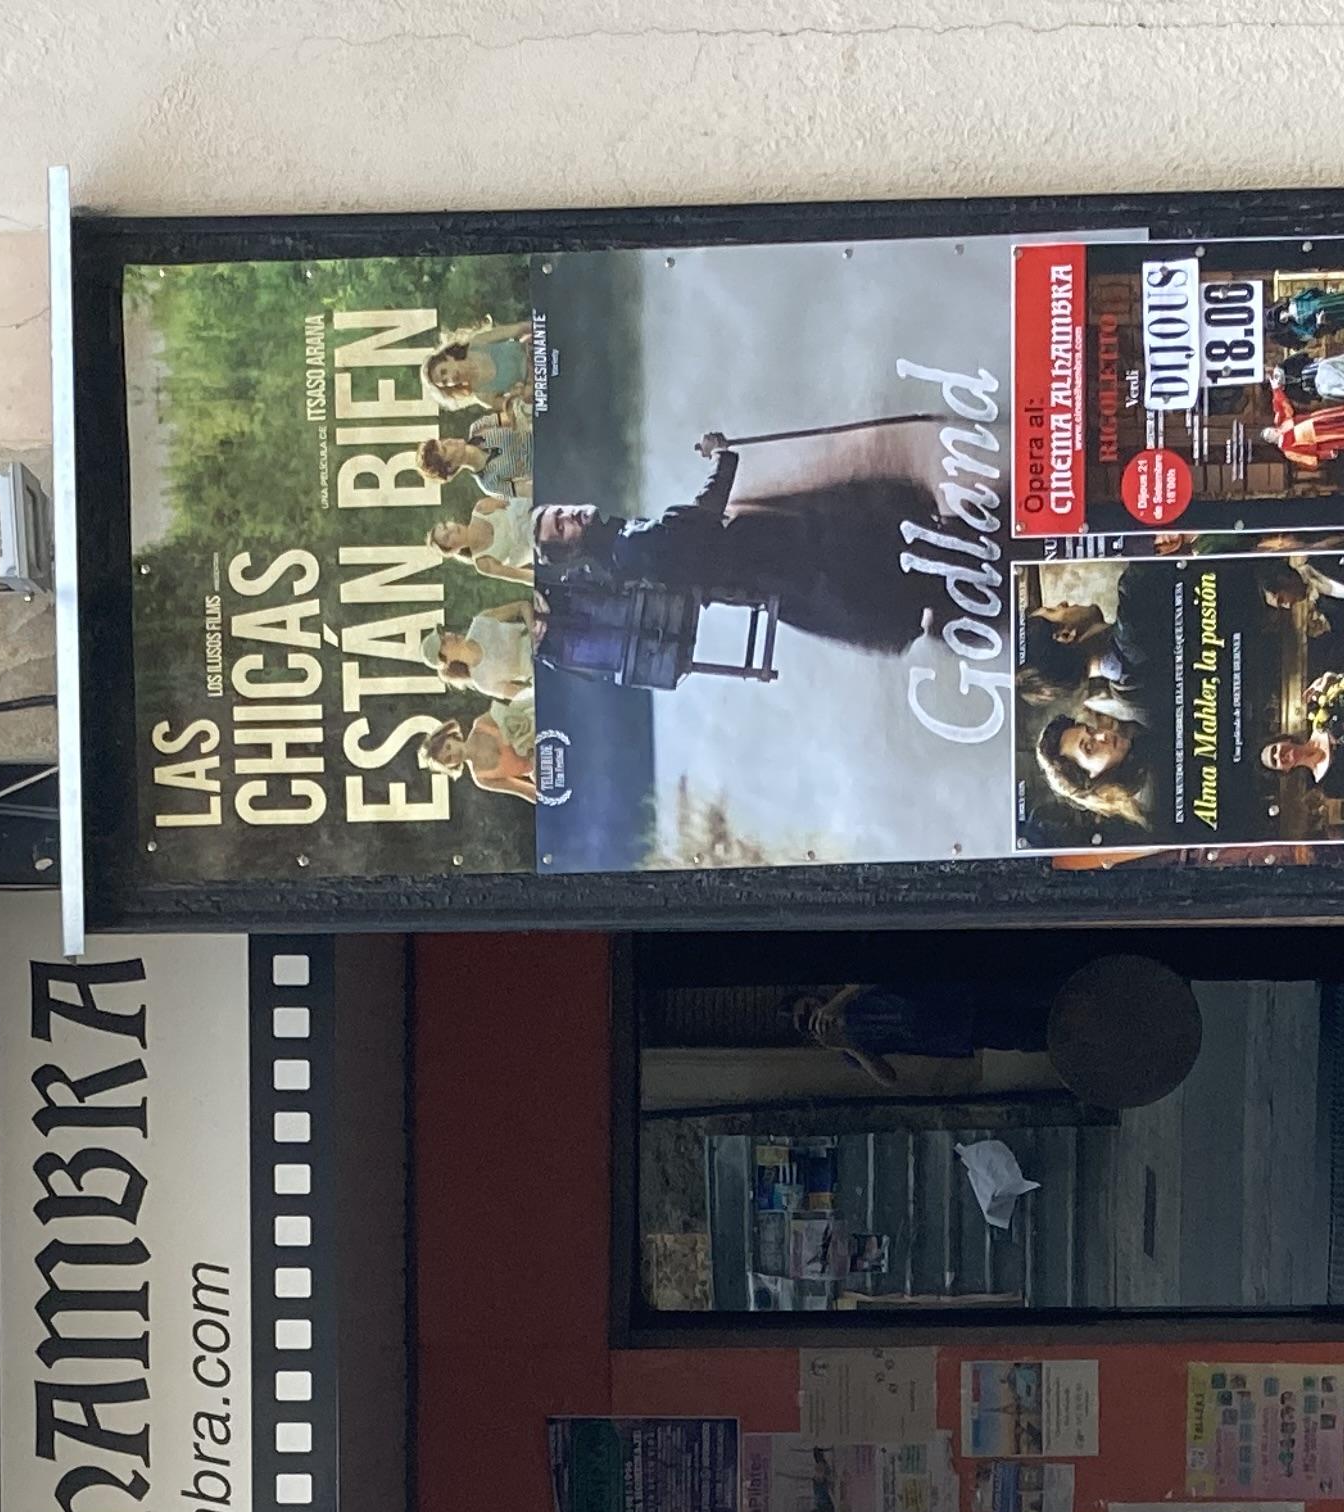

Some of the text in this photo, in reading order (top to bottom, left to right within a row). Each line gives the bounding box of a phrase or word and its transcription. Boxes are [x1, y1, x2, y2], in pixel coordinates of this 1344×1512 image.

[304, 314, 326, 367] ARANA
[1146, 268, 1196, 400] DIJOUS
[1204, 281, 1255, 385] 18.00
[306, 368, 327, 421] ITSASO
[1023, 398, 1045, 428] al:
[1049, 263, 1075, 515] CINEMA ALHAMBRA
[1099, 312, 1119, 462] RIGOLETTO
[1125, 369, 1140, 408] Verdi
[1137, 459, 1149, 510] Dijous 21
[323, 308, 450, 823] ESTÁN BIEN
[895, 357, 1011, 744] Godland
[205, 594, 222, 630] FILMS
[206, 632, 223, 672] ILUSOS
[207, 674, 224, 697] LOS
[228, 549, 327, 826] CHICAS
[1192, 572, 1225, 829] Alma Mahler, la pasión
[152, 719, 222, 828] LAS
